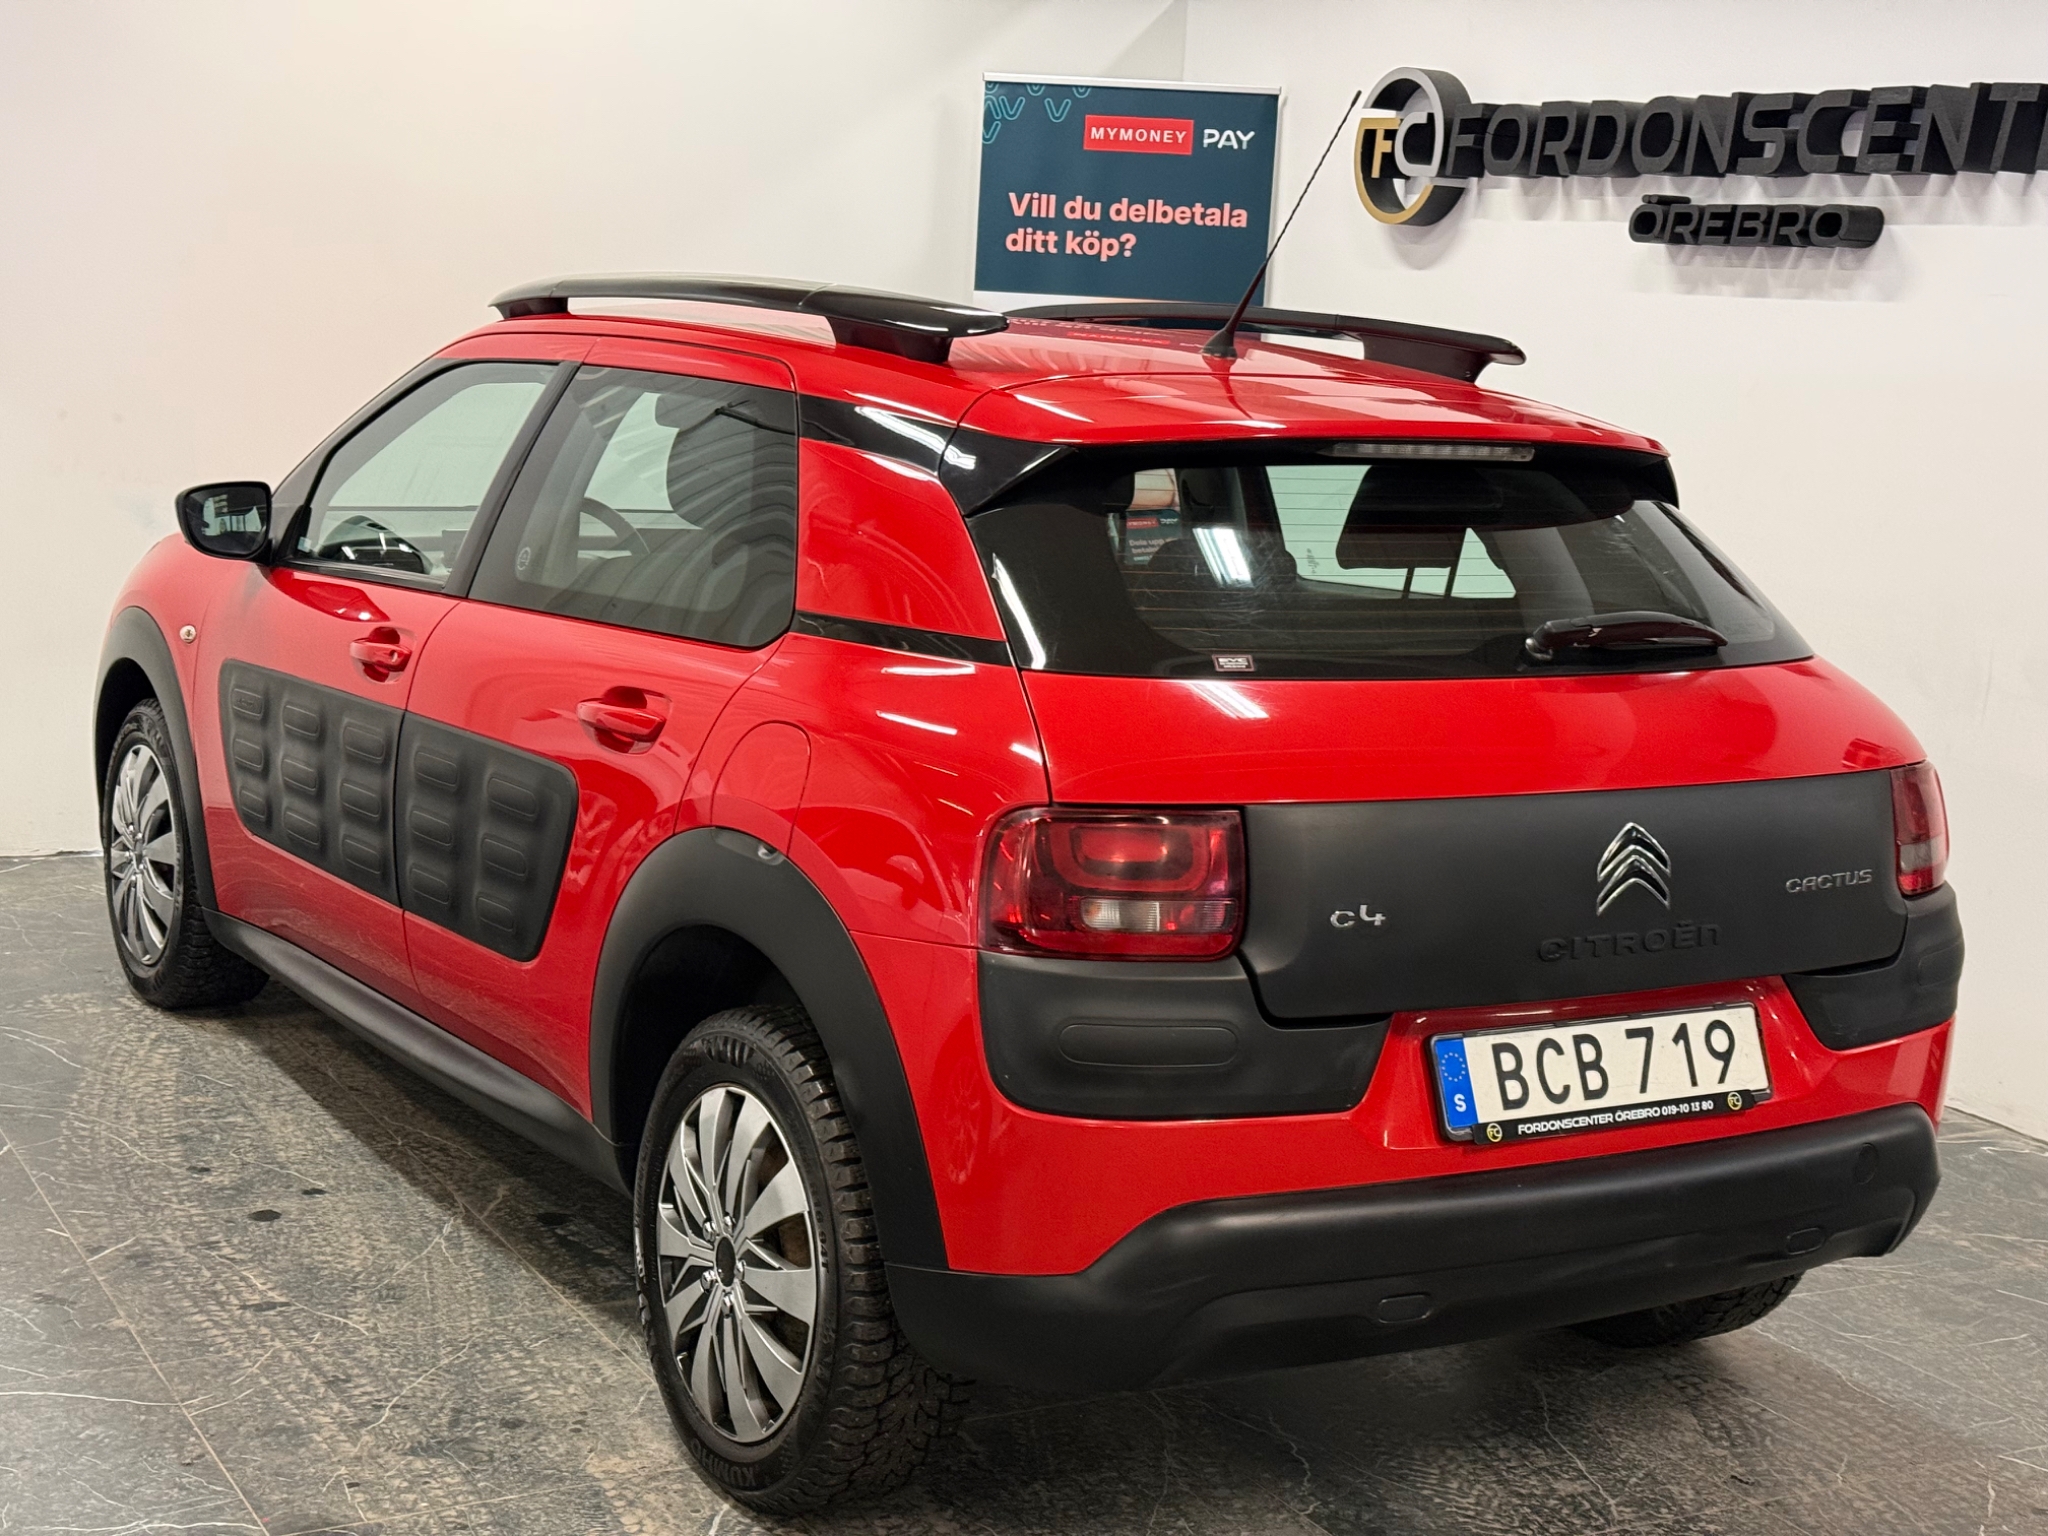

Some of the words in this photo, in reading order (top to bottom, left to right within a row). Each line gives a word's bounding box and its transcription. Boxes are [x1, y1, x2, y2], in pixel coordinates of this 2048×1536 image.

[1090, 126, 1187, 144] MYMONEY
[1203, 128, 1255, 149] PAY
[1009, 192, 1056, 218] Vill
[1063, 195, 1101, 220] du
[1109, 198, 1248, 228] delbetala
[1005, 227, 1058, 254] ditt
[1065, 230, 1137, 262] köp?
[1785, 868, 1873, 893] CACTUS
[1491, 1033, 1610, 1111] BCB
[1624, 1019, 1736, 1094] 719
[1453, 1093, 1467, 1113] S
[1518, 1112, 1614, 1135] FORDONSCENTER
[1615, 1107, 1661, 1122] ÖREBRO
[1662, 1103, 1690, 1116] 019-10
[1700, 1100, 1714, 1111] 80
